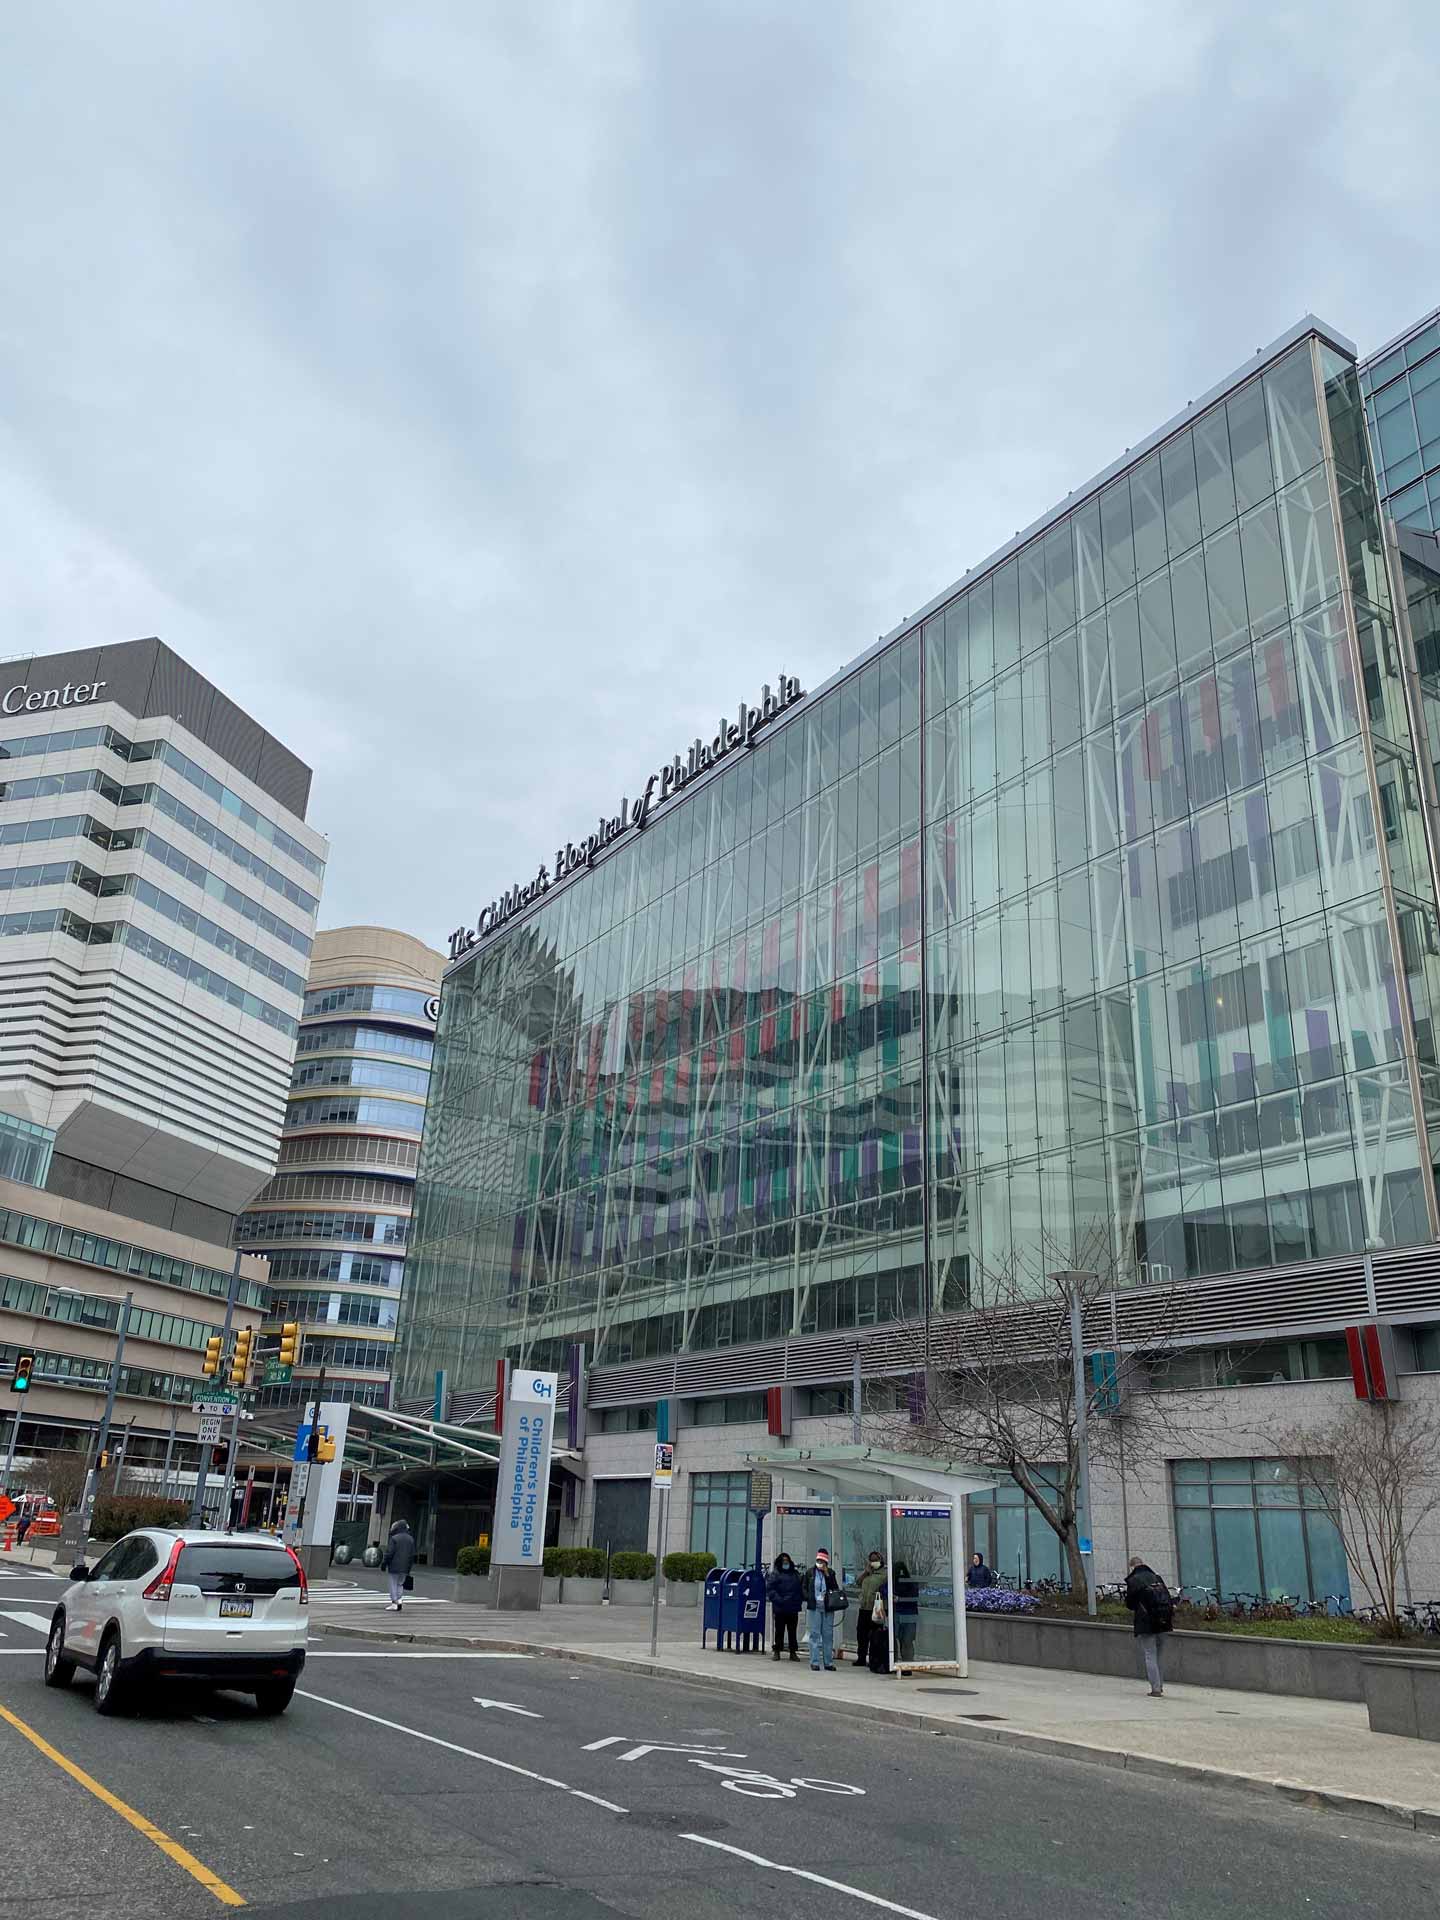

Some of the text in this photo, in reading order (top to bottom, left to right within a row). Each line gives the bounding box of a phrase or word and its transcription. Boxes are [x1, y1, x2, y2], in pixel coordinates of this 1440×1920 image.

[2, 681, 107, 714] Center
[448, 674, 802, 960] The Children's Hospital of Philadelphia
[195, 1394, 230, 1403] CONVENTION
[201, 1418, 221, 1426] BEGIN
[202, 1426, 217, 1434] ONE
[510, 1416, 530, 1530] of Philadelphia
[520, 1417, 544, 1558] Children's Hospital
